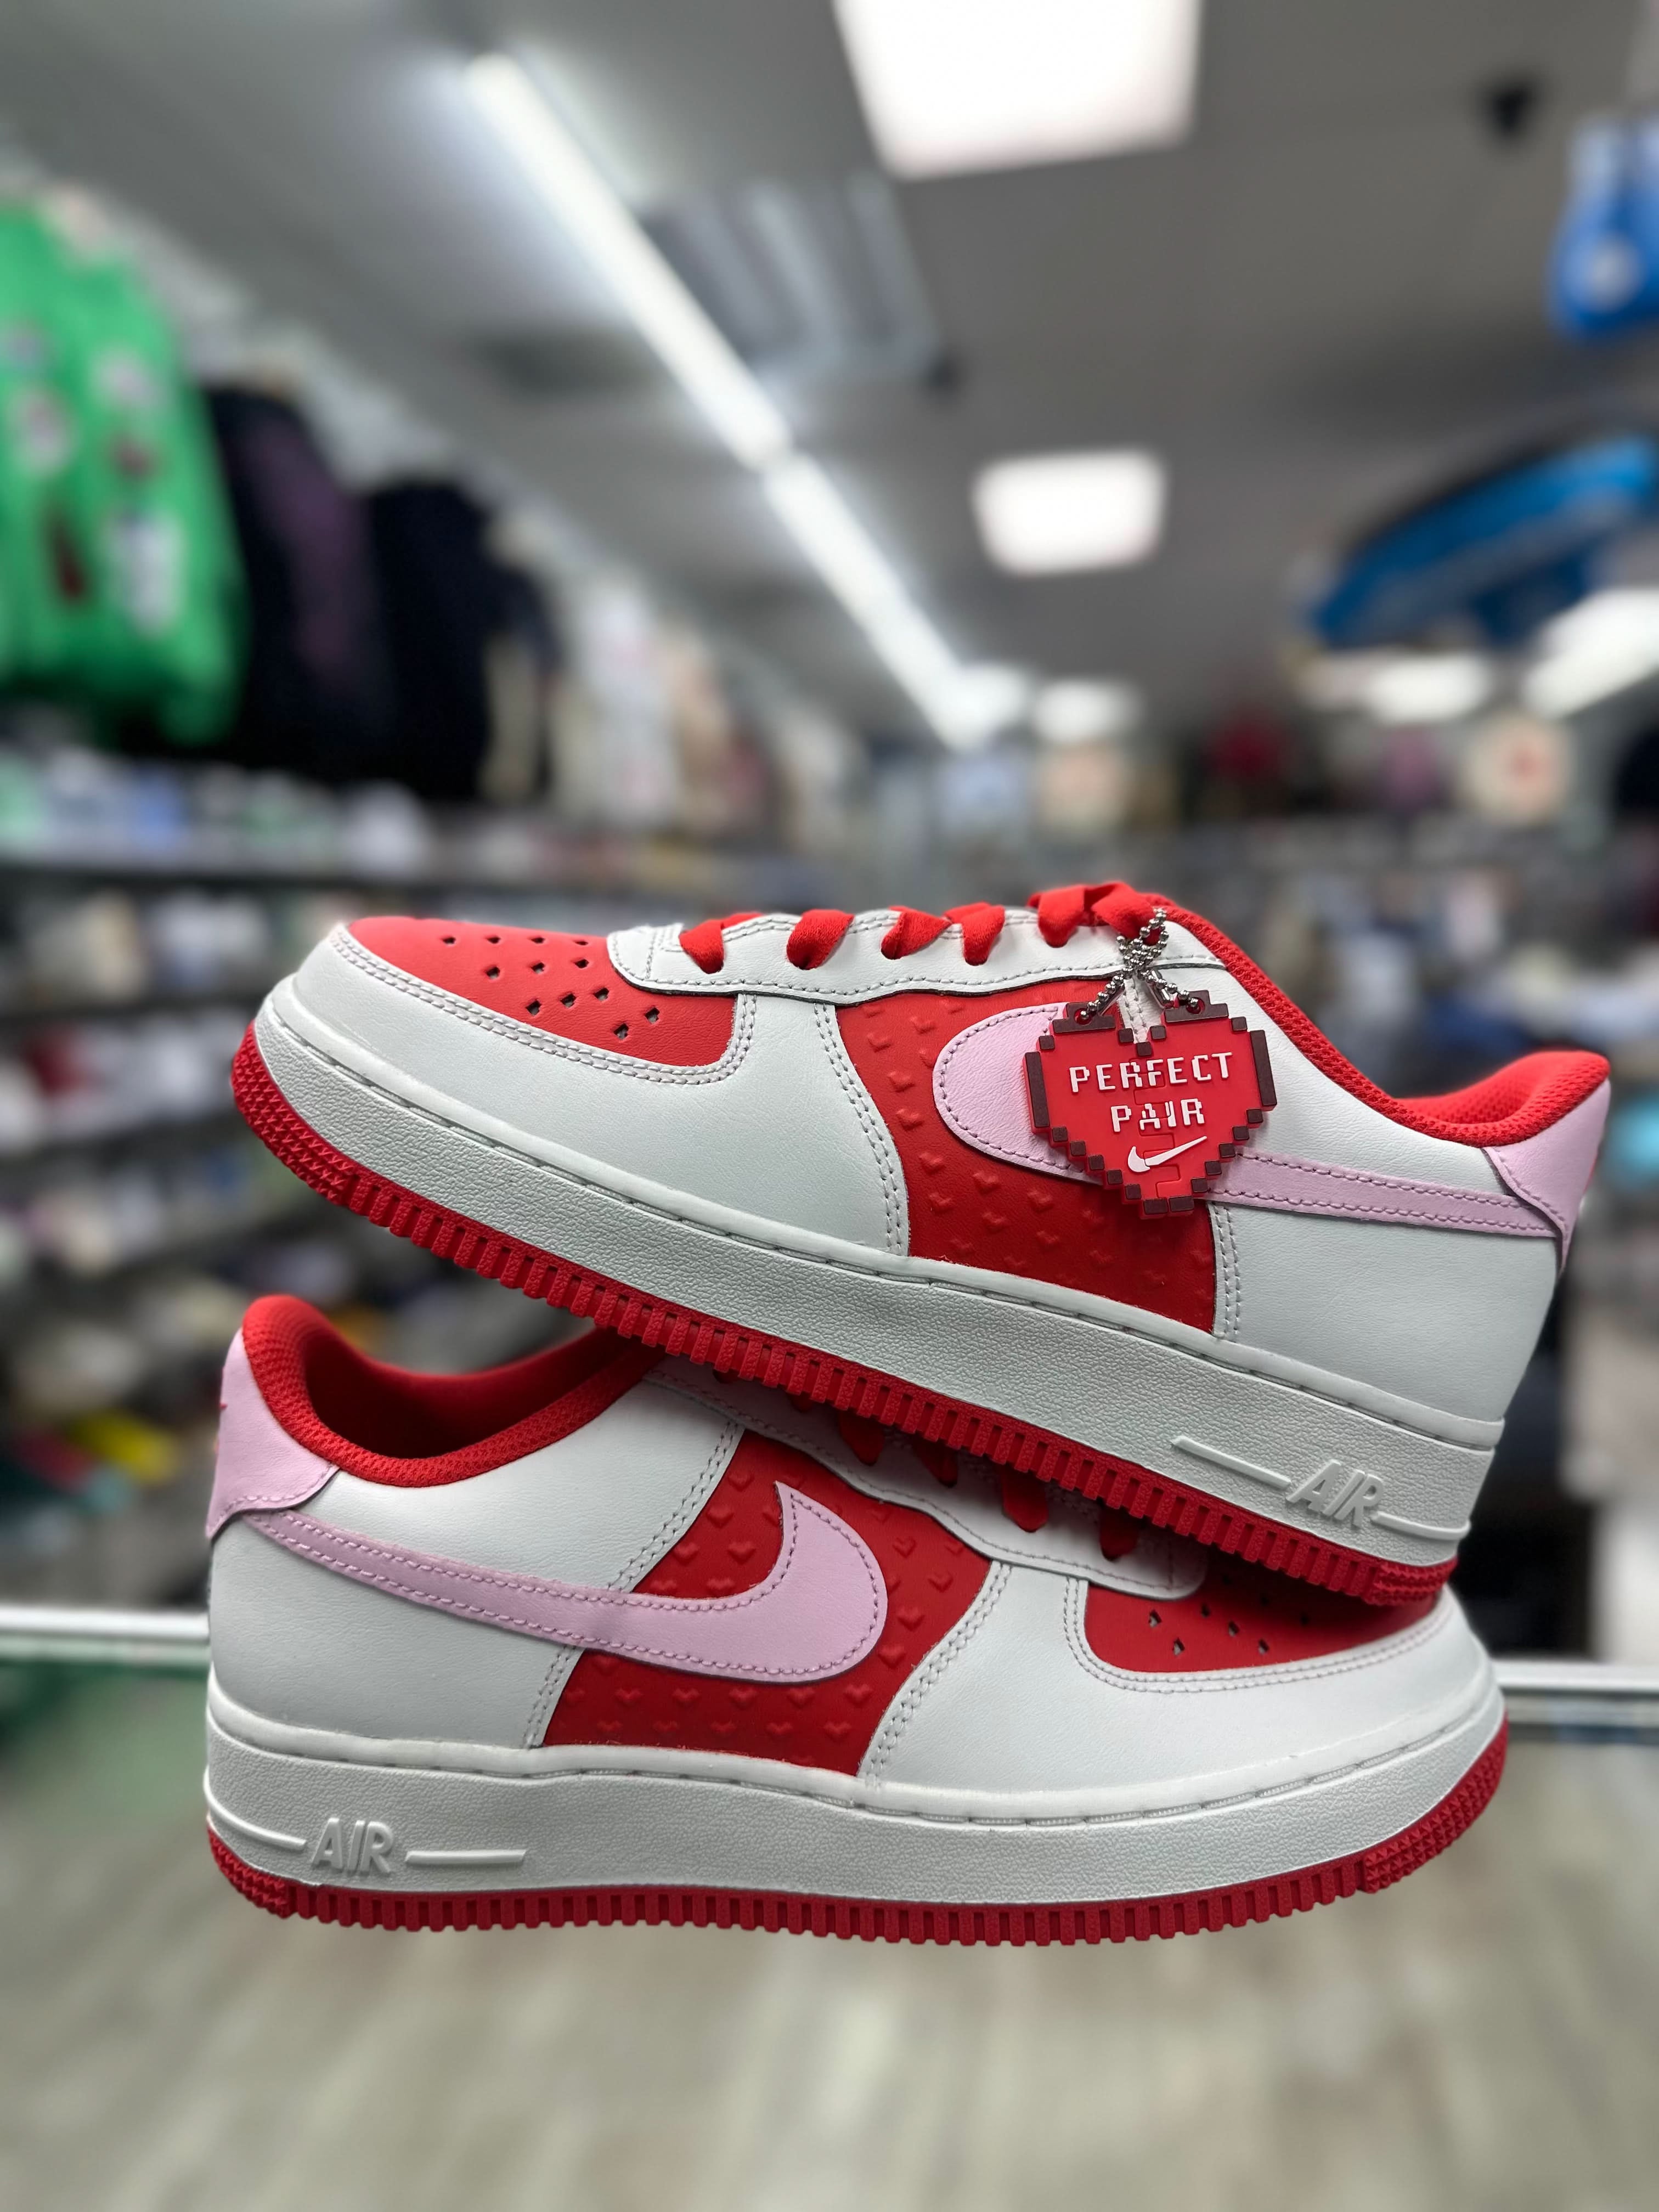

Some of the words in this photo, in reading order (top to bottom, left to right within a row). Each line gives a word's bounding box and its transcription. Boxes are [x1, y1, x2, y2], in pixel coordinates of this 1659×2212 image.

[1069, 1052, 1232, 1093] PERFECT
[1110, 1098, 1205, 1132] PAIR
[1286, 1459, 1383, 1528] AIR
[311, 1817, 393, 1875] AIR
